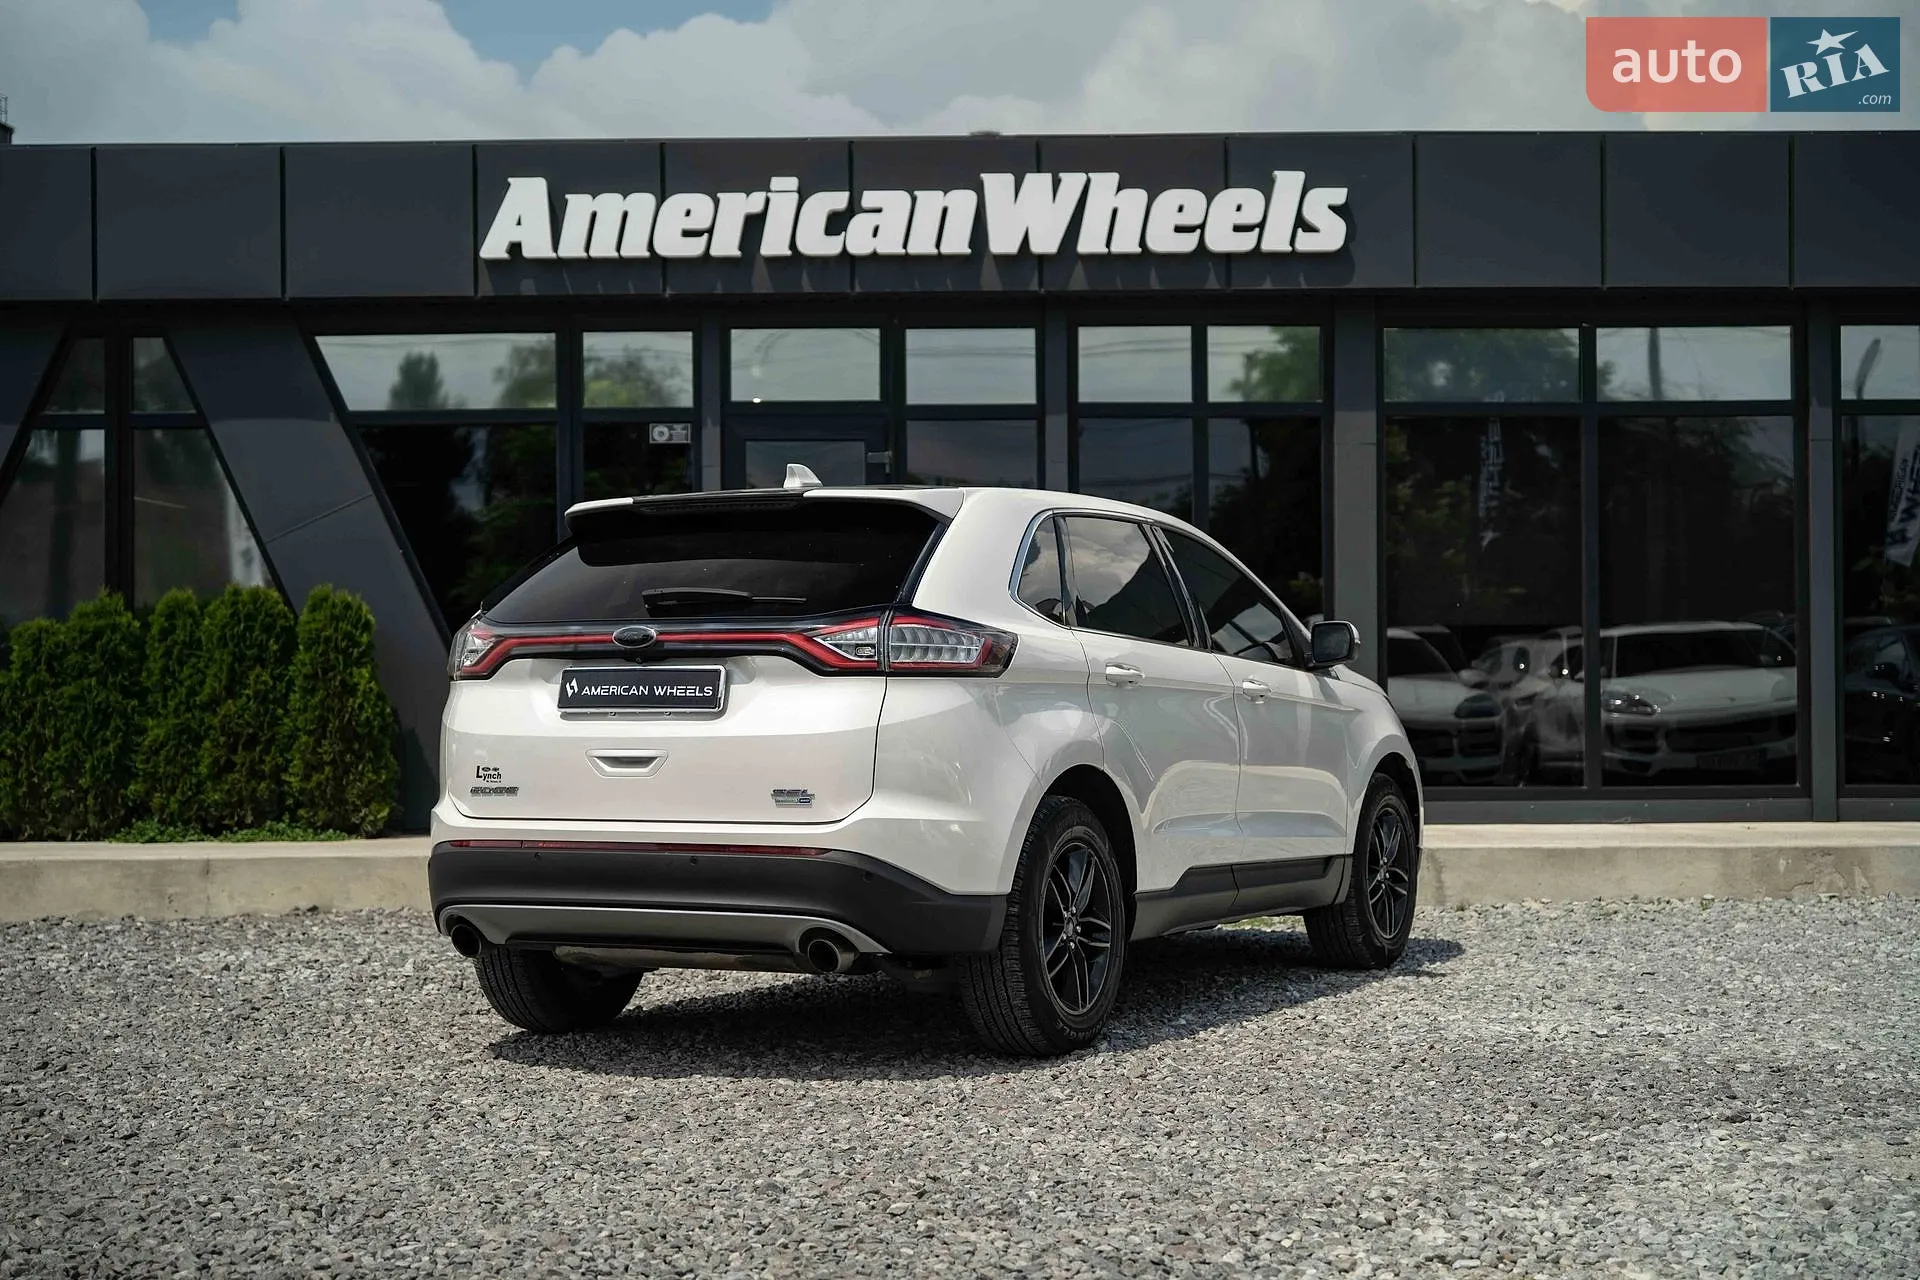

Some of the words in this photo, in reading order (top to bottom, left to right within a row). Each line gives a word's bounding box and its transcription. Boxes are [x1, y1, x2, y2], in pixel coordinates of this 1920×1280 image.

[581, 685, 649, 696] AMERICAN
[653, 685, 713, 697] WHEELS
[475, 765, 502, 781] Lynch
